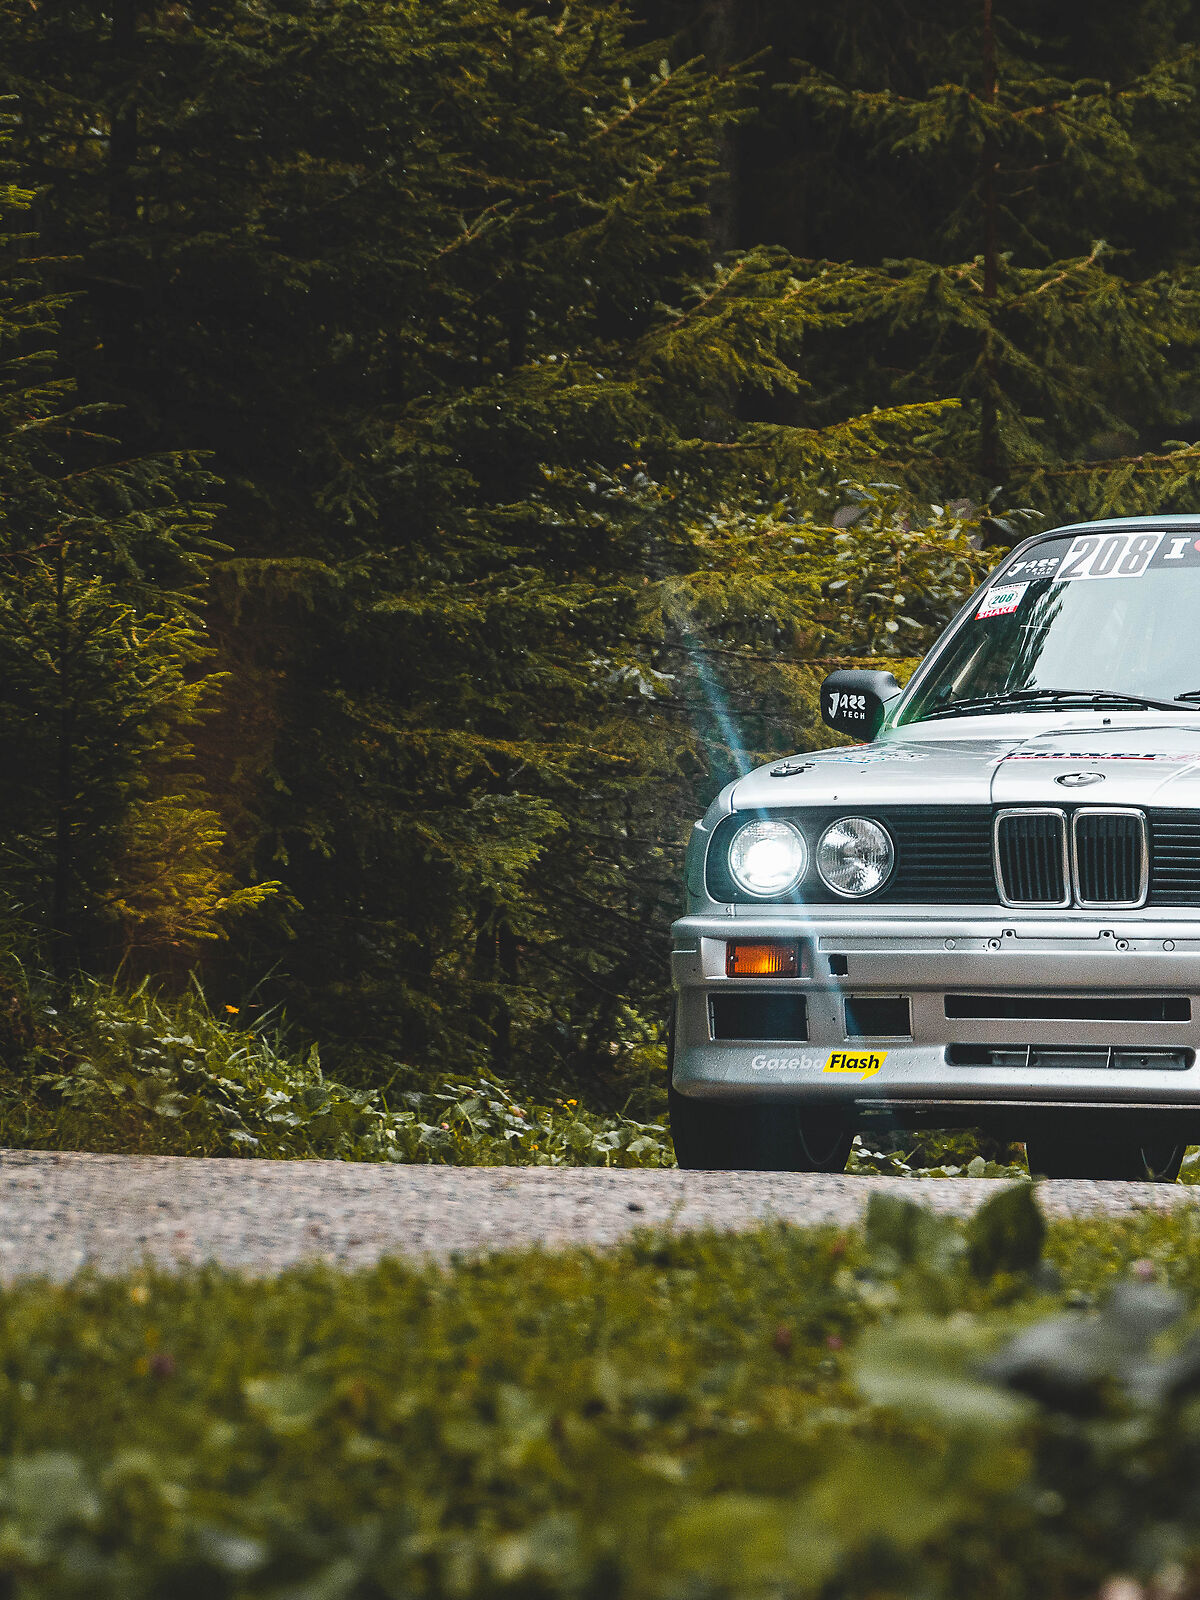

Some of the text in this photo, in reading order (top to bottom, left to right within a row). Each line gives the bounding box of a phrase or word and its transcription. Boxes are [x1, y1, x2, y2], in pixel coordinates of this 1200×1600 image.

[1163, 537, 1191, 560] I
[1058, 535, 1159, 579] 208
[991, 592, 1013, 605] 208
[976, 605, 1016, 620] SHAKE
[842, 710, 866, 720] TECH
[751, 1053, 880, 1071] Gazebo Flash
